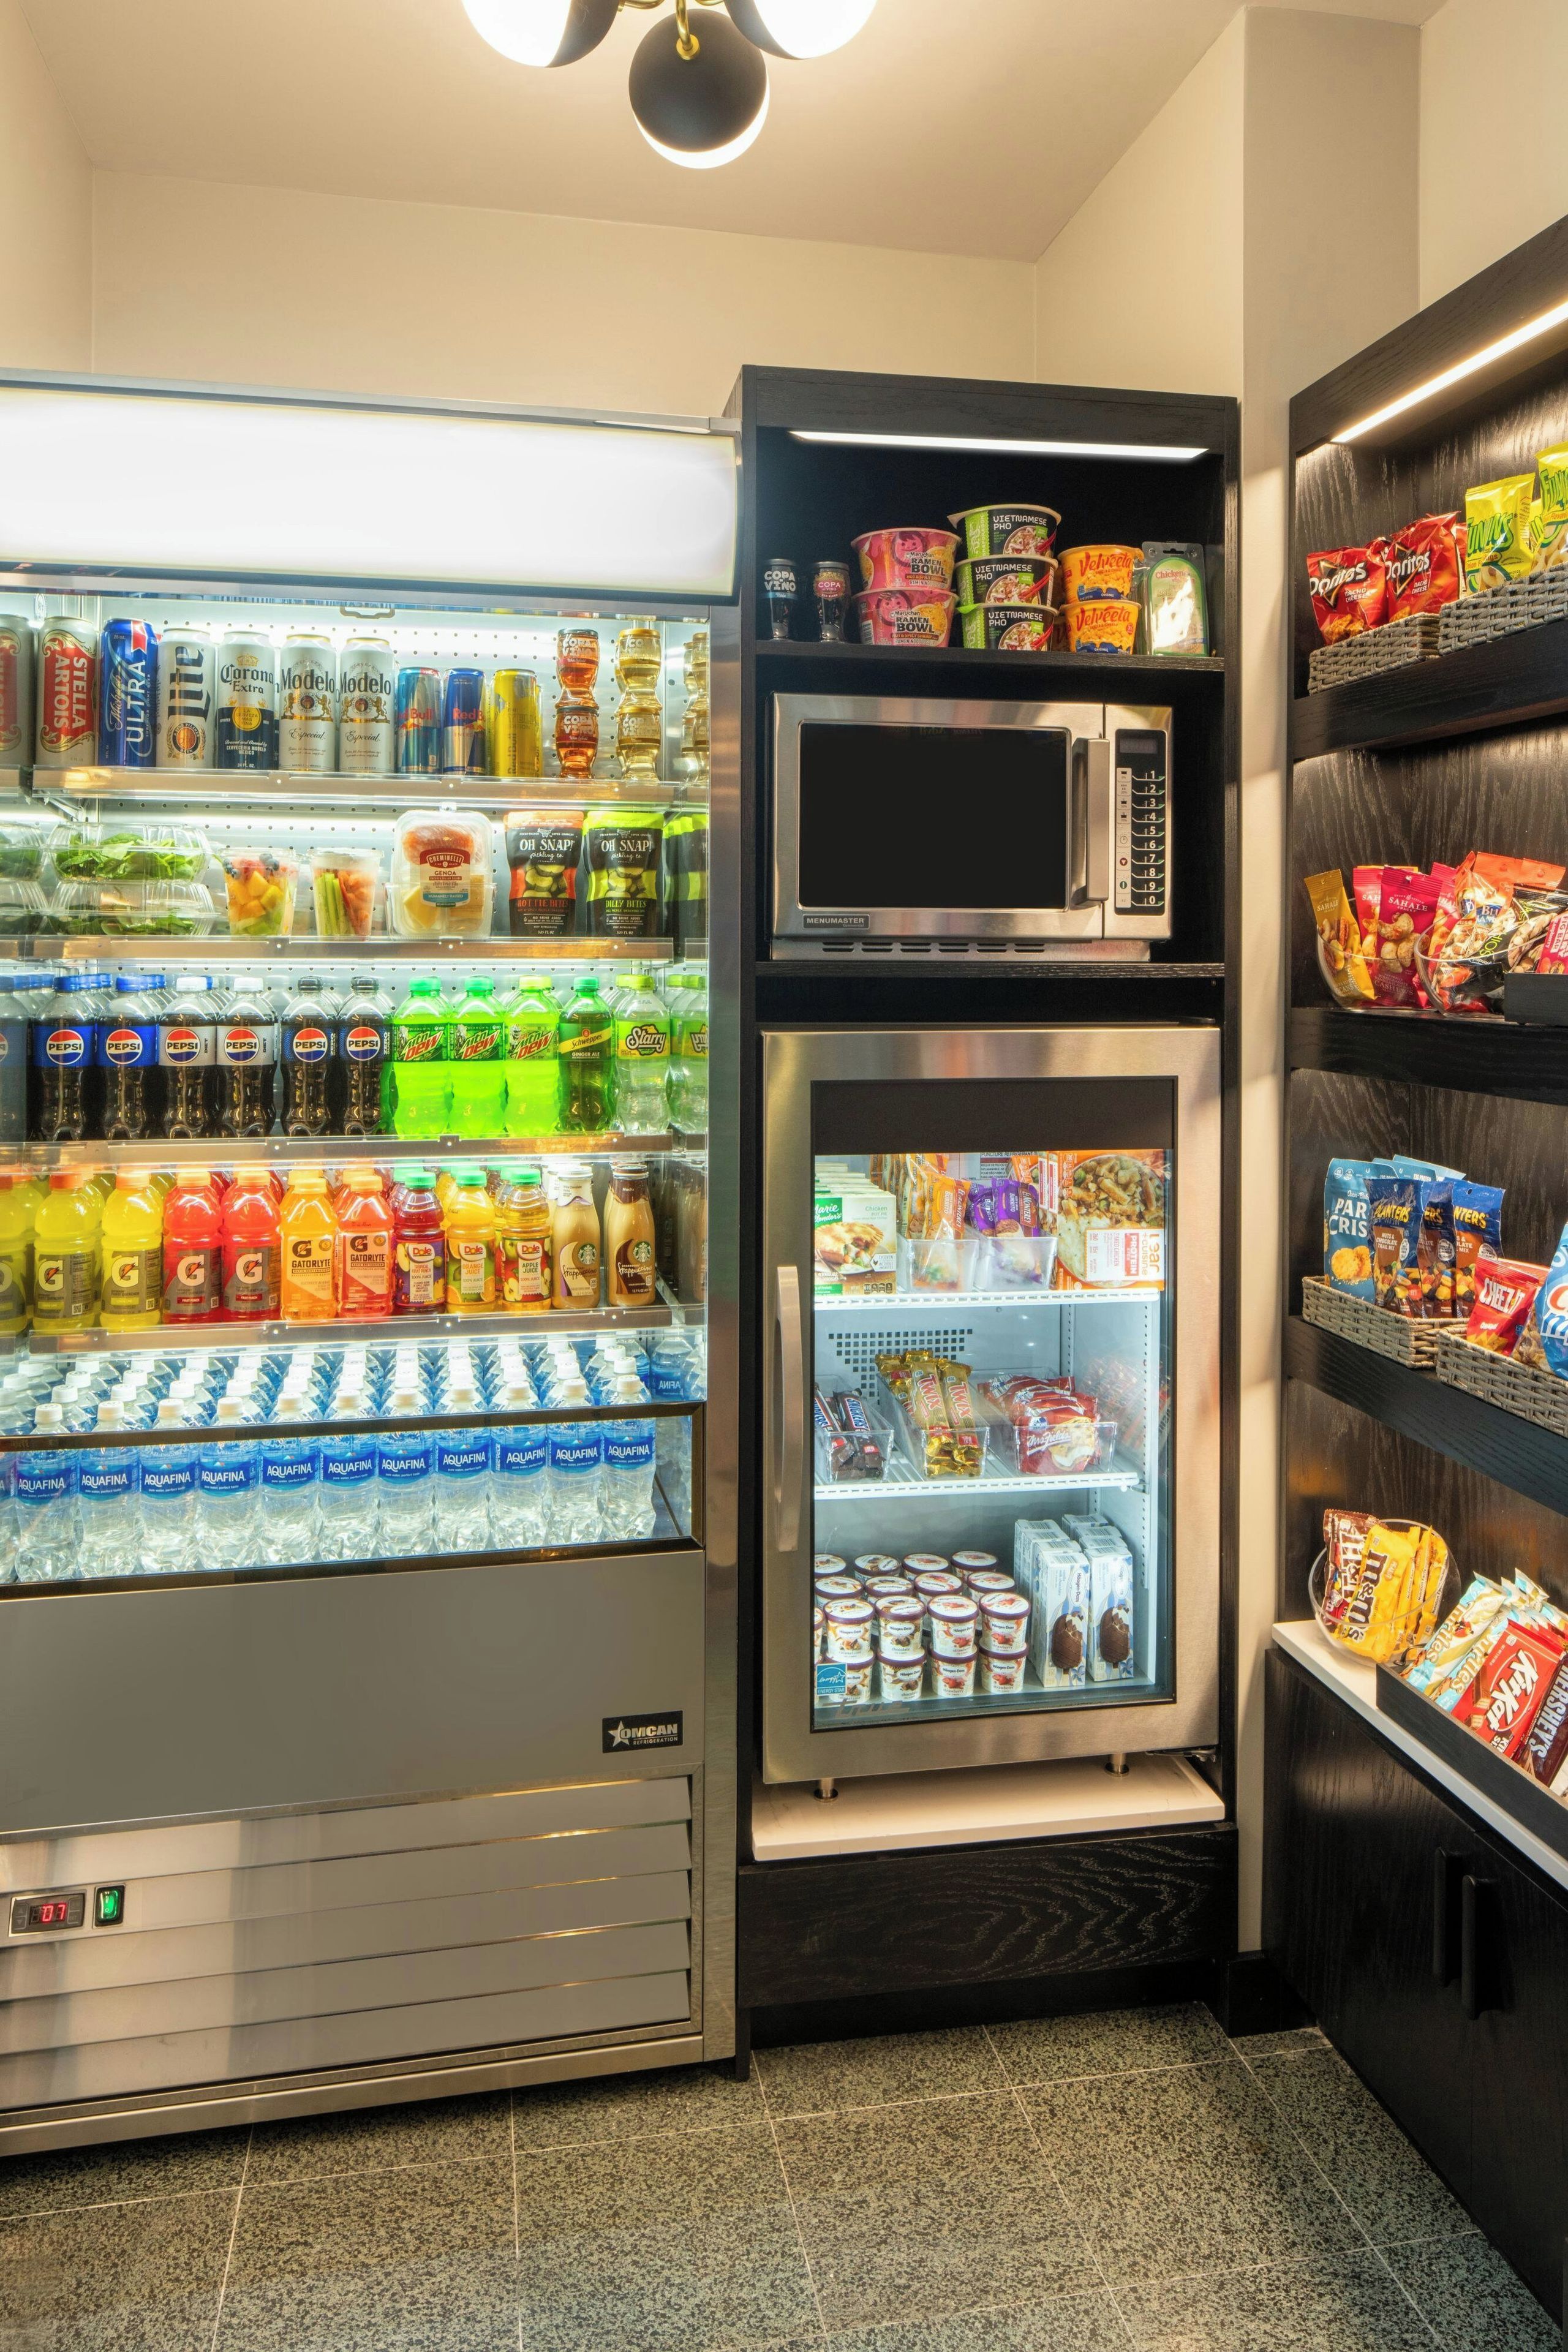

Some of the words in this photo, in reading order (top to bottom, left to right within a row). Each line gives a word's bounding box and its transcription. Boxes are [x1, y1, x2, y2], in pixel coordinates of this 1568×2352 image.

[993, 514, 1047, 526] VIETNAMESE
[911, 564, 946, 576] BOWL
[975, 564, 1033, 573] VIETNAMESE
[1079, 551, 1133, 577] Velveeta
[1385, 551, 1430, 581] Doritos
[764, 570, 796, 582] COPA
[976, 573, 993, 581] PHO
[1155, 570, 1183, 579] Chicken
[1310, 562, 1367, 596] Doritos
[764, 581, 796, 592] VINO
[1344, 588, 1366, 597] NACHO
[1411, 586, 1428, 594] CHEESE
[1346, 593, 1367, 603] CHEESE
[988, 611, 1043, 621] VIETNAMESE
[1076, 606, 1131, 632] Velveeta
[896, 623, 935, 633] BOWL
[220, 663, 274, 685] Corona
[281, 667, 335, 694] Modelo
[168, 646, 211, 723] Lite
[232, 682, 264, 695] Extra
[340, 671, 391, 696] Modelo
[54, 654, 70, 729] ARTOIS
[72, 657, 88, 729] STELLA
[126, 659, 146, 743] ULTRA
[564, 715, 593, 725] COPA
[288, 727, 326, 741] Especial
[346, 729, 381, 743] Especial
[564, 724, 593, 735] VINO
[1150, 771, 1155, 779] 1
[1150, 785, 1156, 793] 2
[1150, 799, 1156, 807] 3
[1150, 826, 1156, 835] 5
[519, 839, 536, 851] OH
[540, 839, 574, 851] SNAP!
[601, 839, 616, 852] OH
[619, 839, 652, 852] SNAP!
[1150, 840, 1156, 849] 6
[429, 854, 462, 863] CREMINELLI
[530, 851, 555, 861] pickling
[1149, 854, 1156, 862] 7
[1149, 868, 1155, 876] 8
[1149, 881, 1155, 891] 9
[1149, 895, 1155, 904] 0
[1317, 899, 1340, 912] SAHALE
[1388, 897, 1428, 911] SAHALE
[1374, 981, 1414, 995] CASHEWS
[166, 1041, 199, 1050] PEPSI
[225, 1041, 258, 1051] PEPSI
[571, 1034, 603, 1049] Schweppes
[626, 1027, 666, 1052] Starry
[48, 1042, 84, 1052] PEPSI
[107, 1042, 141, 1052] PEPSI
[1374, 1204, 1412, 1223] PLANTERS
[350, 1235, 368, 1253] G
[1376, 1237, 1398, 1246] CHOCOLATE
[292, 1240, 312, 1258] G
[412, 1247, 432, 1256] Dole
[464, 1246, 483, 1255] Dole
[521, 1245, 540, 1254] Dole
[177, 1254, 205, 1286] G
[236, 1253, 263, 1284] G
[292, 1259, 331, 1268] GATORLYTE
[617, 1262, 652, 1278] frappuccino
[38, 1259, 64, 1292] G
[111, 1256, 139, 1287] G
[562, 1264, 597, 1280] frappuccino
[918, 1374, 943, 1410] TWIX
[949, 1381, 973, 1419] TWIX
[846, 1398, 869, 1429] SNICKERS
[1044, 1430, 1070, 1448] Fields
[506, 1447, 546, 1464] AQUAFINA
[556, 1446, 598, 1462] AQUAFINA
[608, 1444, 650, 1458] AQUAFINA
[328, 1458, 372, 1474] AQUAFINA
[382, 1458, 426, 1472] AQUAFINA
[443, 1451, 486, 1467] AQUAFINA
[201, 1470, 245, 1485] AQUAFINA
[266, 1463, 312, 1478] AQUAFINA
[18, 1477, 66, 1493] AQUAFINA
[81, 1473, 128, 1488] AQUAFINA
[144, 1471, 191, 1488] AQUAFINA
[620, 1724, 678, 1739] OMCAN
[633, 1736, 678, 1746] REFRIGERATION
